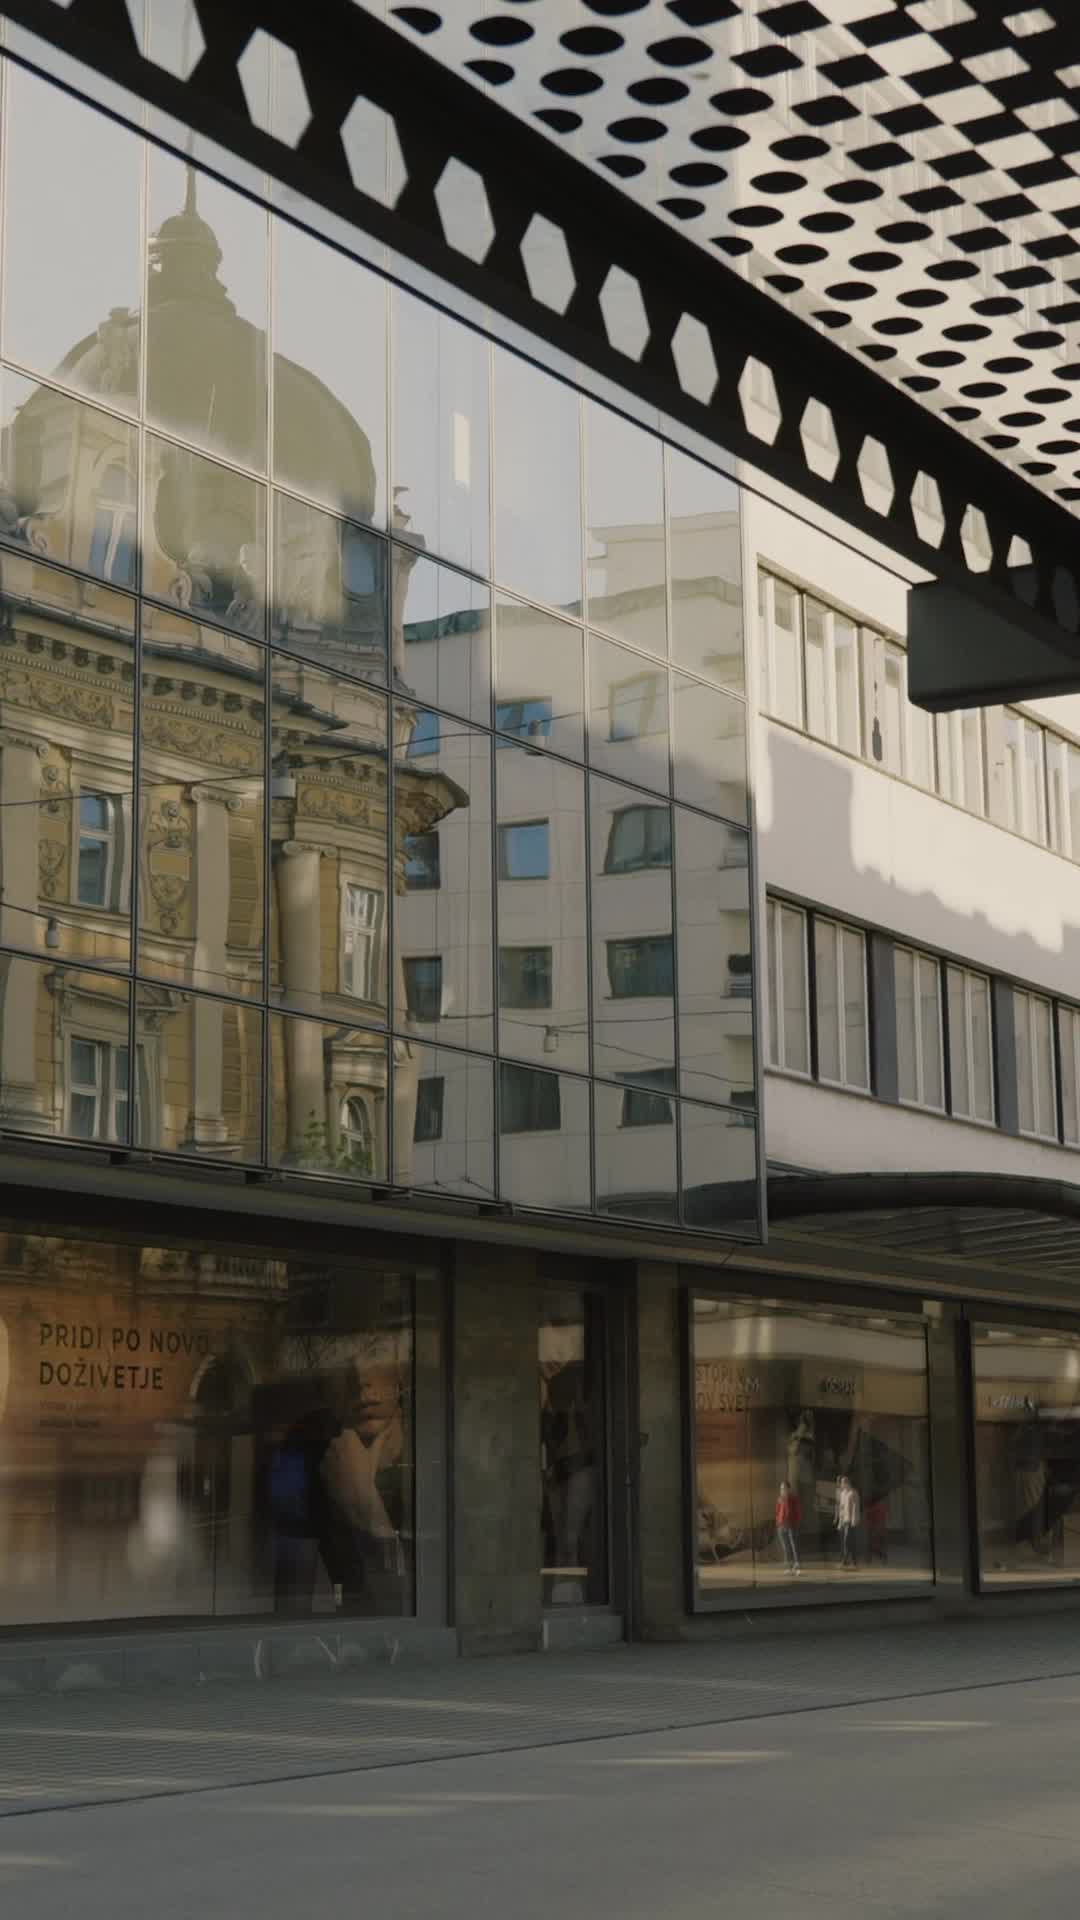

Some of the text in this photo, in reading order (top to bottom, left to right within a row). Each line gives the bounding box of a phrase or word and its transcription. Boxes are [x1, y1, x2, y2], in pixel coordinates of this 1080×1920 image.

[39, 1323, 209, 1354] PRIDI PO NOVO
[39, 1357, 164, 1390] DOŽIVETJE
